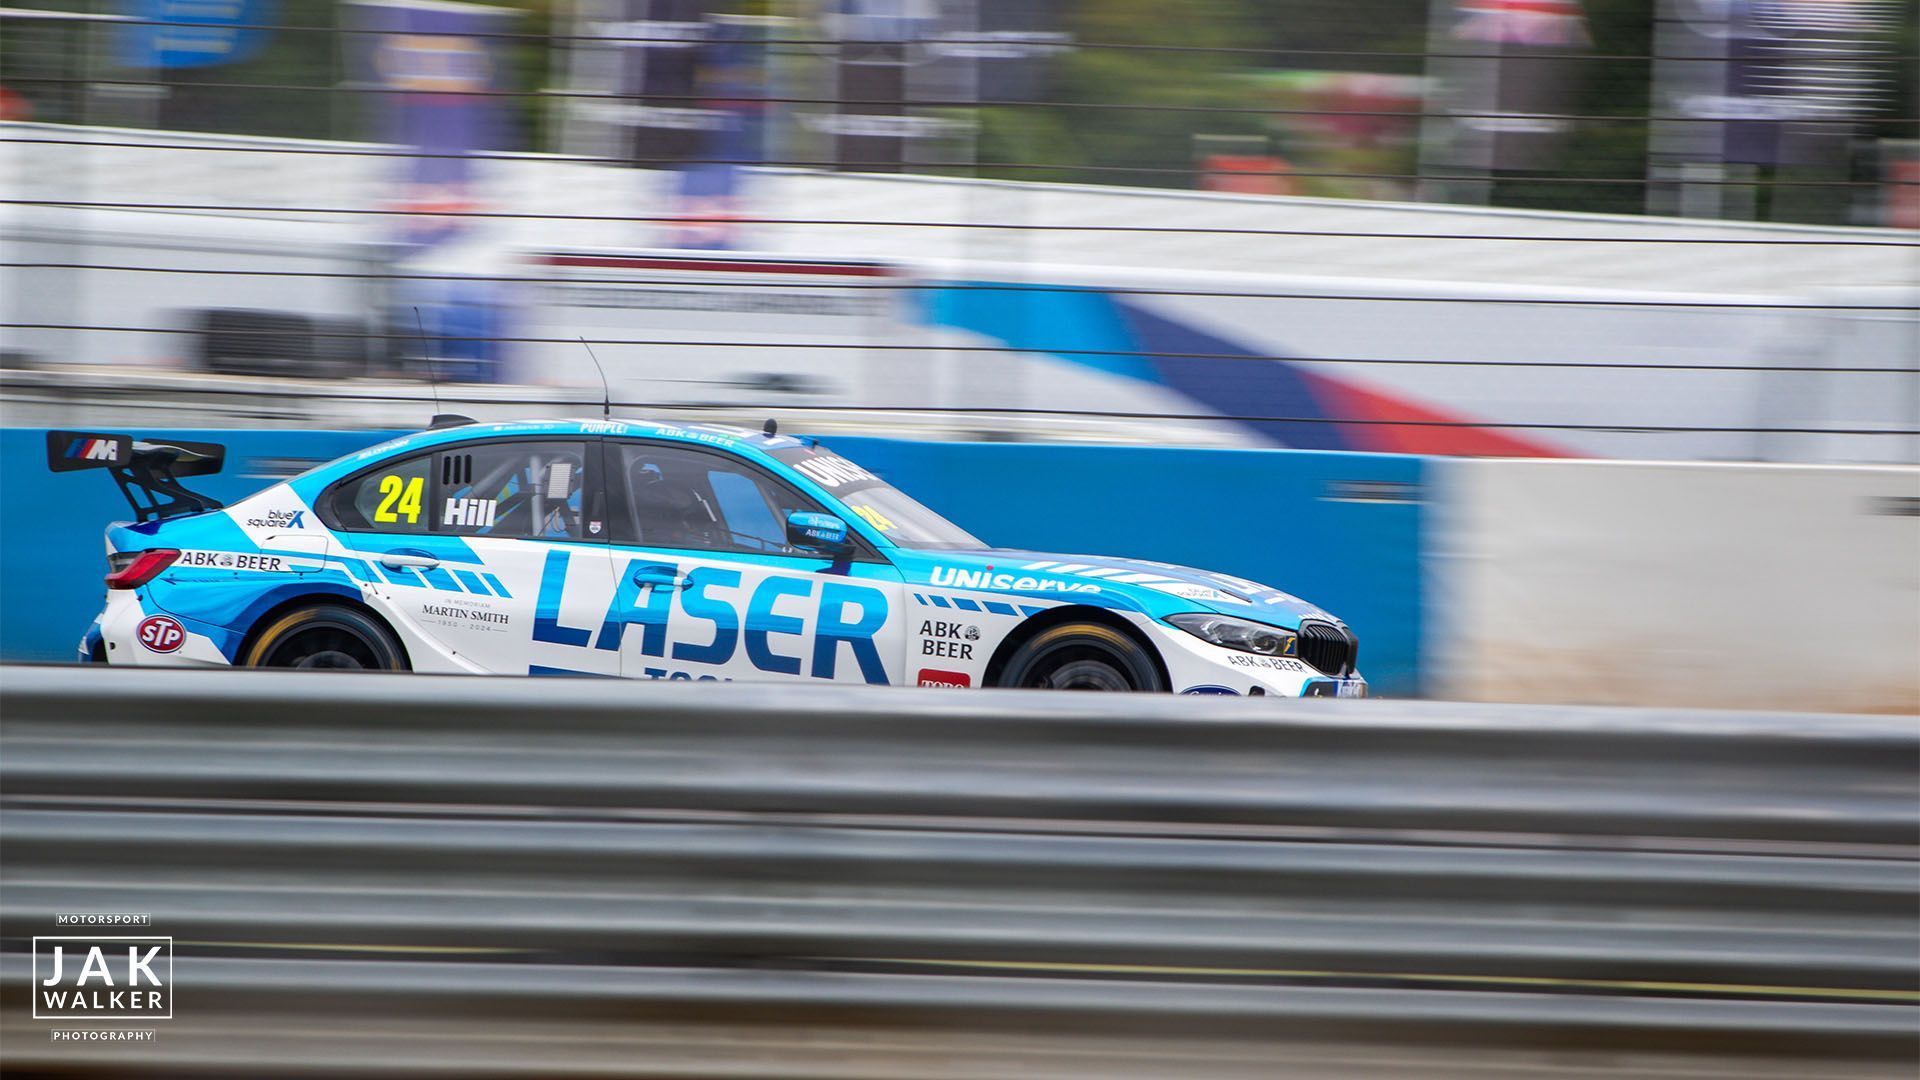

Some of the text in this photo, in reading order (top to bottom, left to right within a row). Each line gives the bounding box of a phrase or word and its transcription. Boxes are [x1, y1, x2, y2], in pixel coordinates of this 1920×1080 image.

[85, 439, 118, 461] M
[374, 475, 424, 524] 24
[247, 518, 287, 528] square
[268, 510, 293, 520] blue
[443, 498, 497, 527] Hill
[851, 505, 898, 531] 24
[181, 552, 281, 571] ABK BEER
[422, 604, 510, 624] MARTIN SMITH
[532, 549, 890, 686] LASER
[142, 620, 182, 647] STP
[919, 620, 963, 639] ABK
[922, 639, 974, 660] BEER
[1227, 655, 1308, 674] ABK BEER
